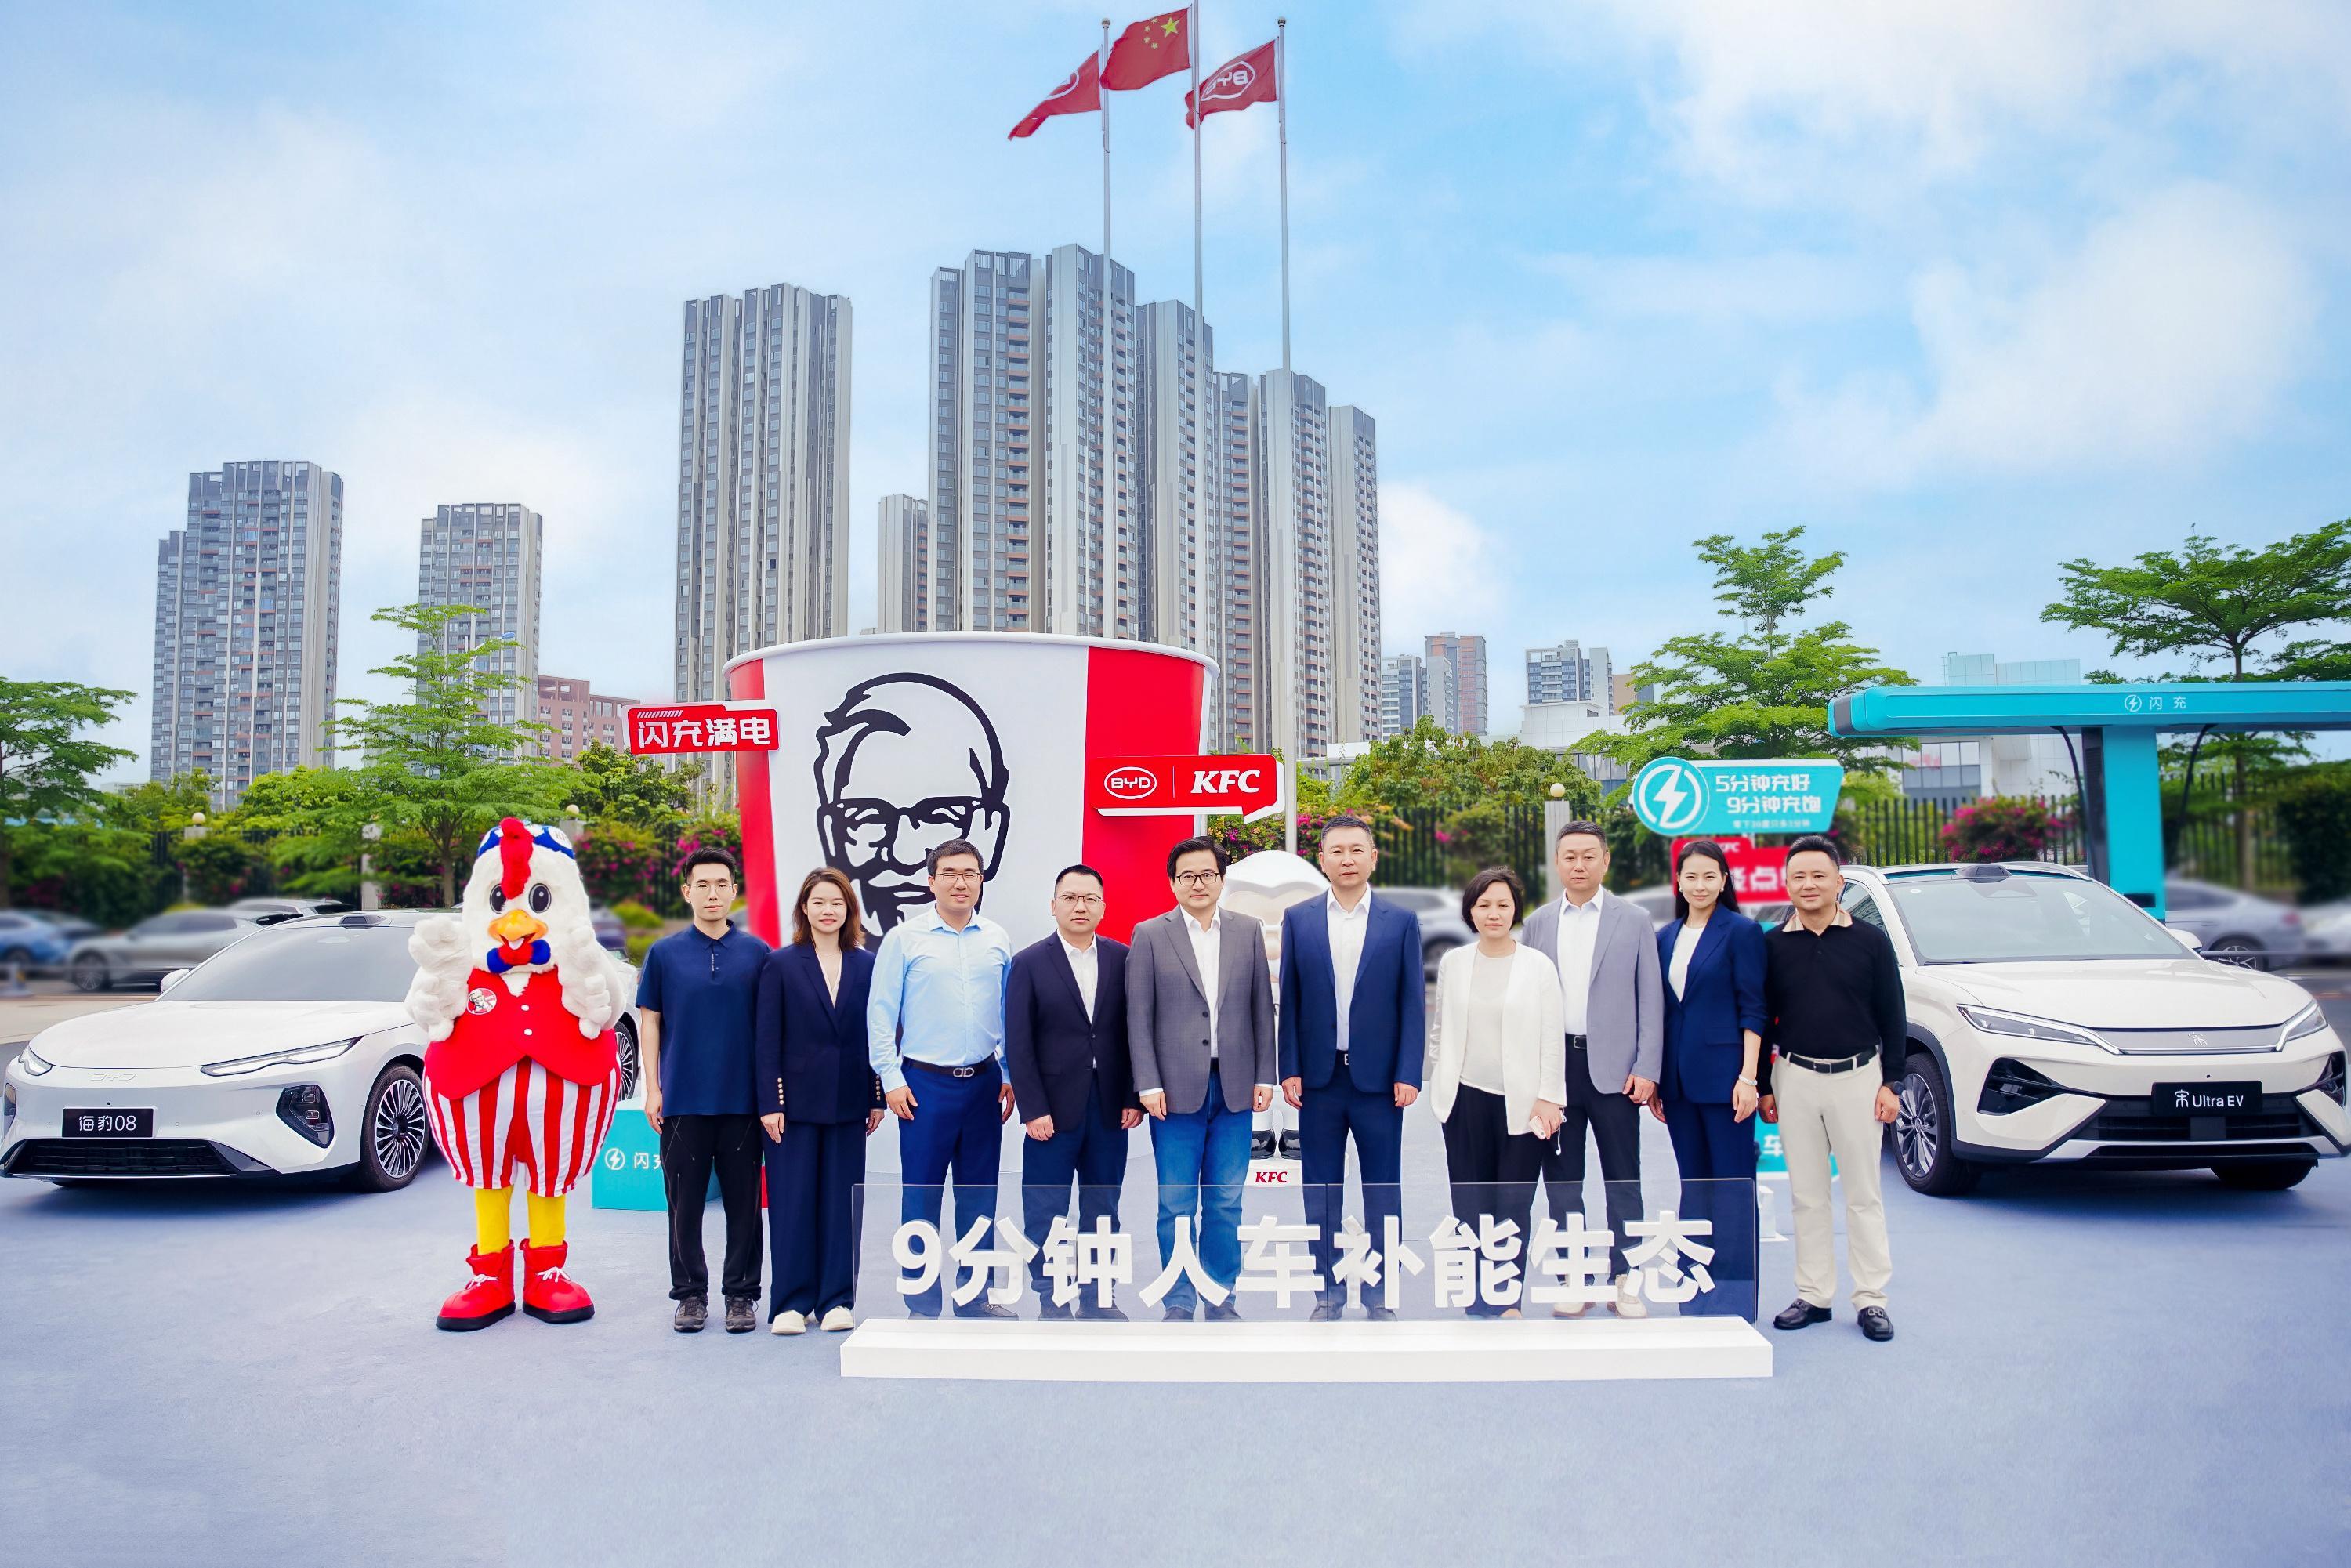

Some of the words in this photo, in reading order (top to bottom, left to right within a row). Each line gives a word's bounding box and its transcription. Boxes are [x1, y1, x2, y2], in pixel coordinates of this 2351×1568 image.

[2150, 696, 2186, 711] 闪充
[638, 716, 771, 749] 闪充满电
[1110, 777, 1152, 790] BYD
[1190, 770, 1261, 794] KFC
[1715, 773, 1811, 793] 5分钟充好
[1726, 795, 1822, 814] 9分钟充饱
[2192, 1095, 2225, 1107] Ultra
[2227, 1095, 2244, 1107] EV
[79, 1115, 136, 1132] 海豹08
[1254, 1171, 1288, 1183] KFC
[892, 1211, 1716, 1308] 9分钟人车补能生态
